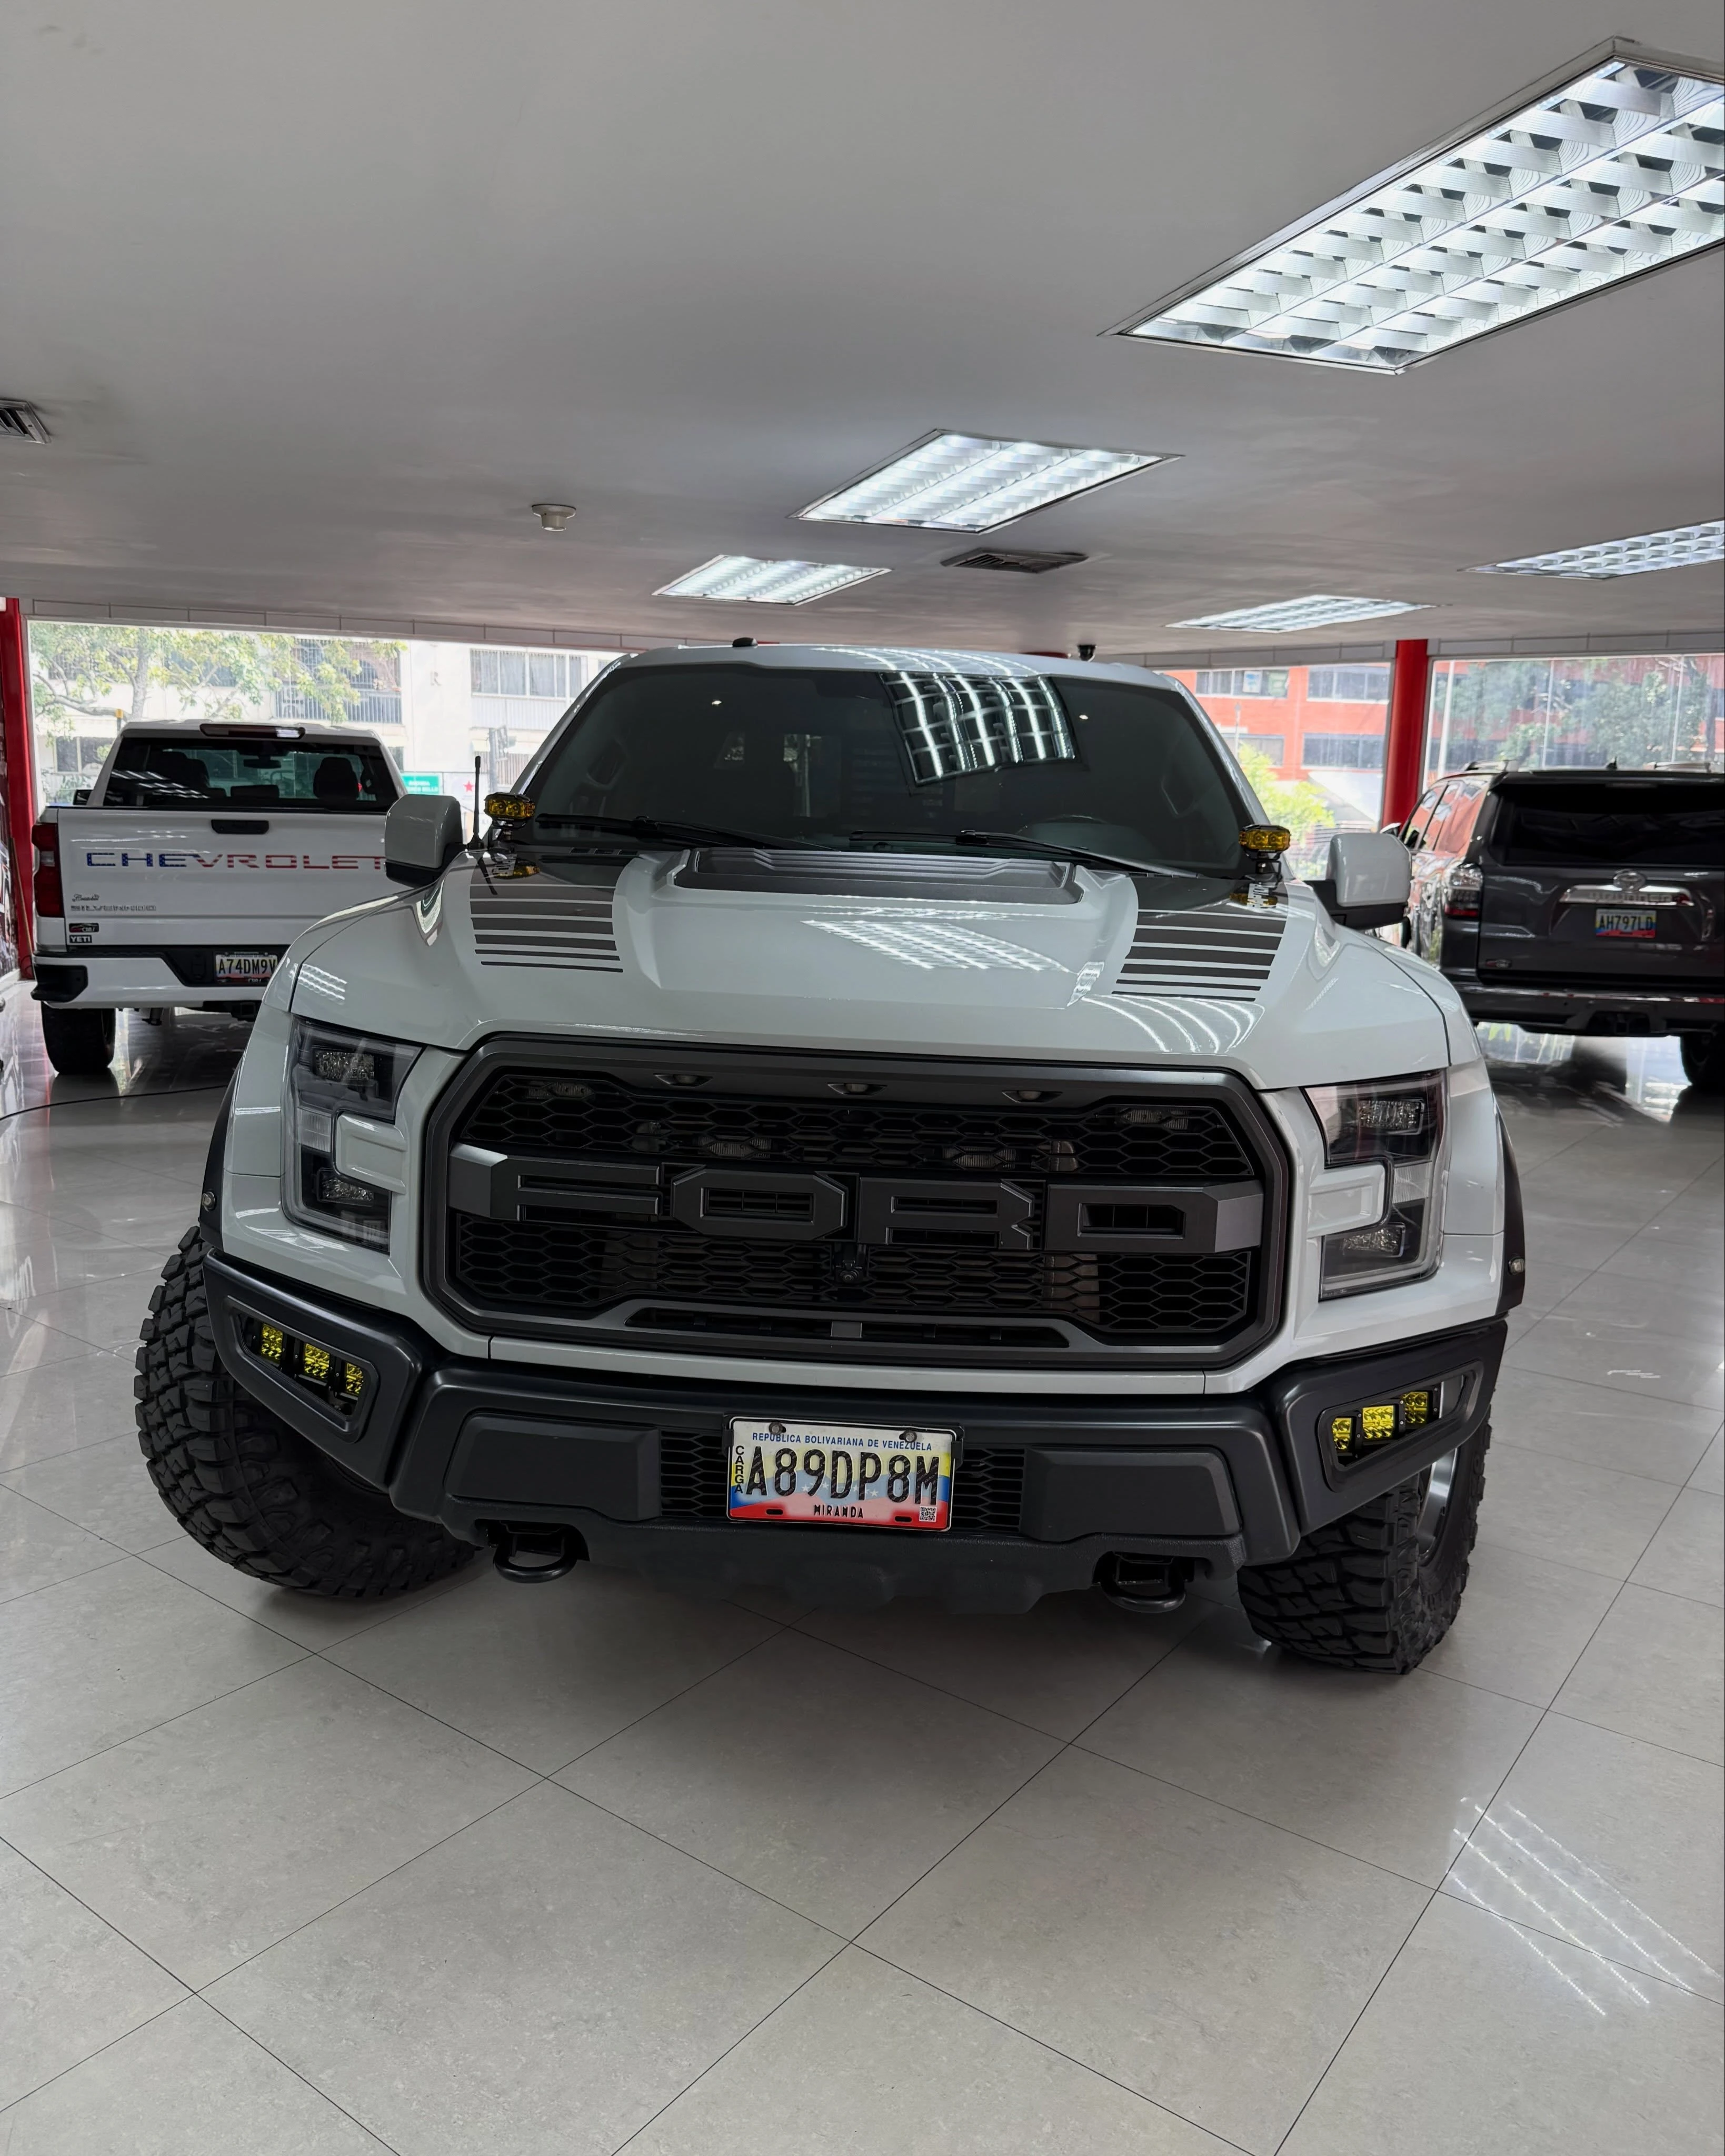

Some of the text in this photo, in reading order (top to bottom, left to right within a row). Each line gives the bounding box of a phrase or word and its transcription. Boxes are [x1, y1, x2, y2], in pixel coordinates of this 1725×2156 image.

[86, 852, 386, 870] CHEVROLET
[1599, 915, 1653, 931] AH797LD
[218, 959, 276, 974] A74DM9V
[490, 1155, 1220, 1253] FORD
[752, 1432, 801, 1443] REPUBLICA
[805, 1435, 864, 1446] BOLIVARIANA
[882, 1440, 932, 1451] VENEZUELA
[734, 1445, 744, 1493] CARGA
[746, 1446, 940, 1505] A89DP8M
[814, 1504, 863, 1519] MIRANDA
